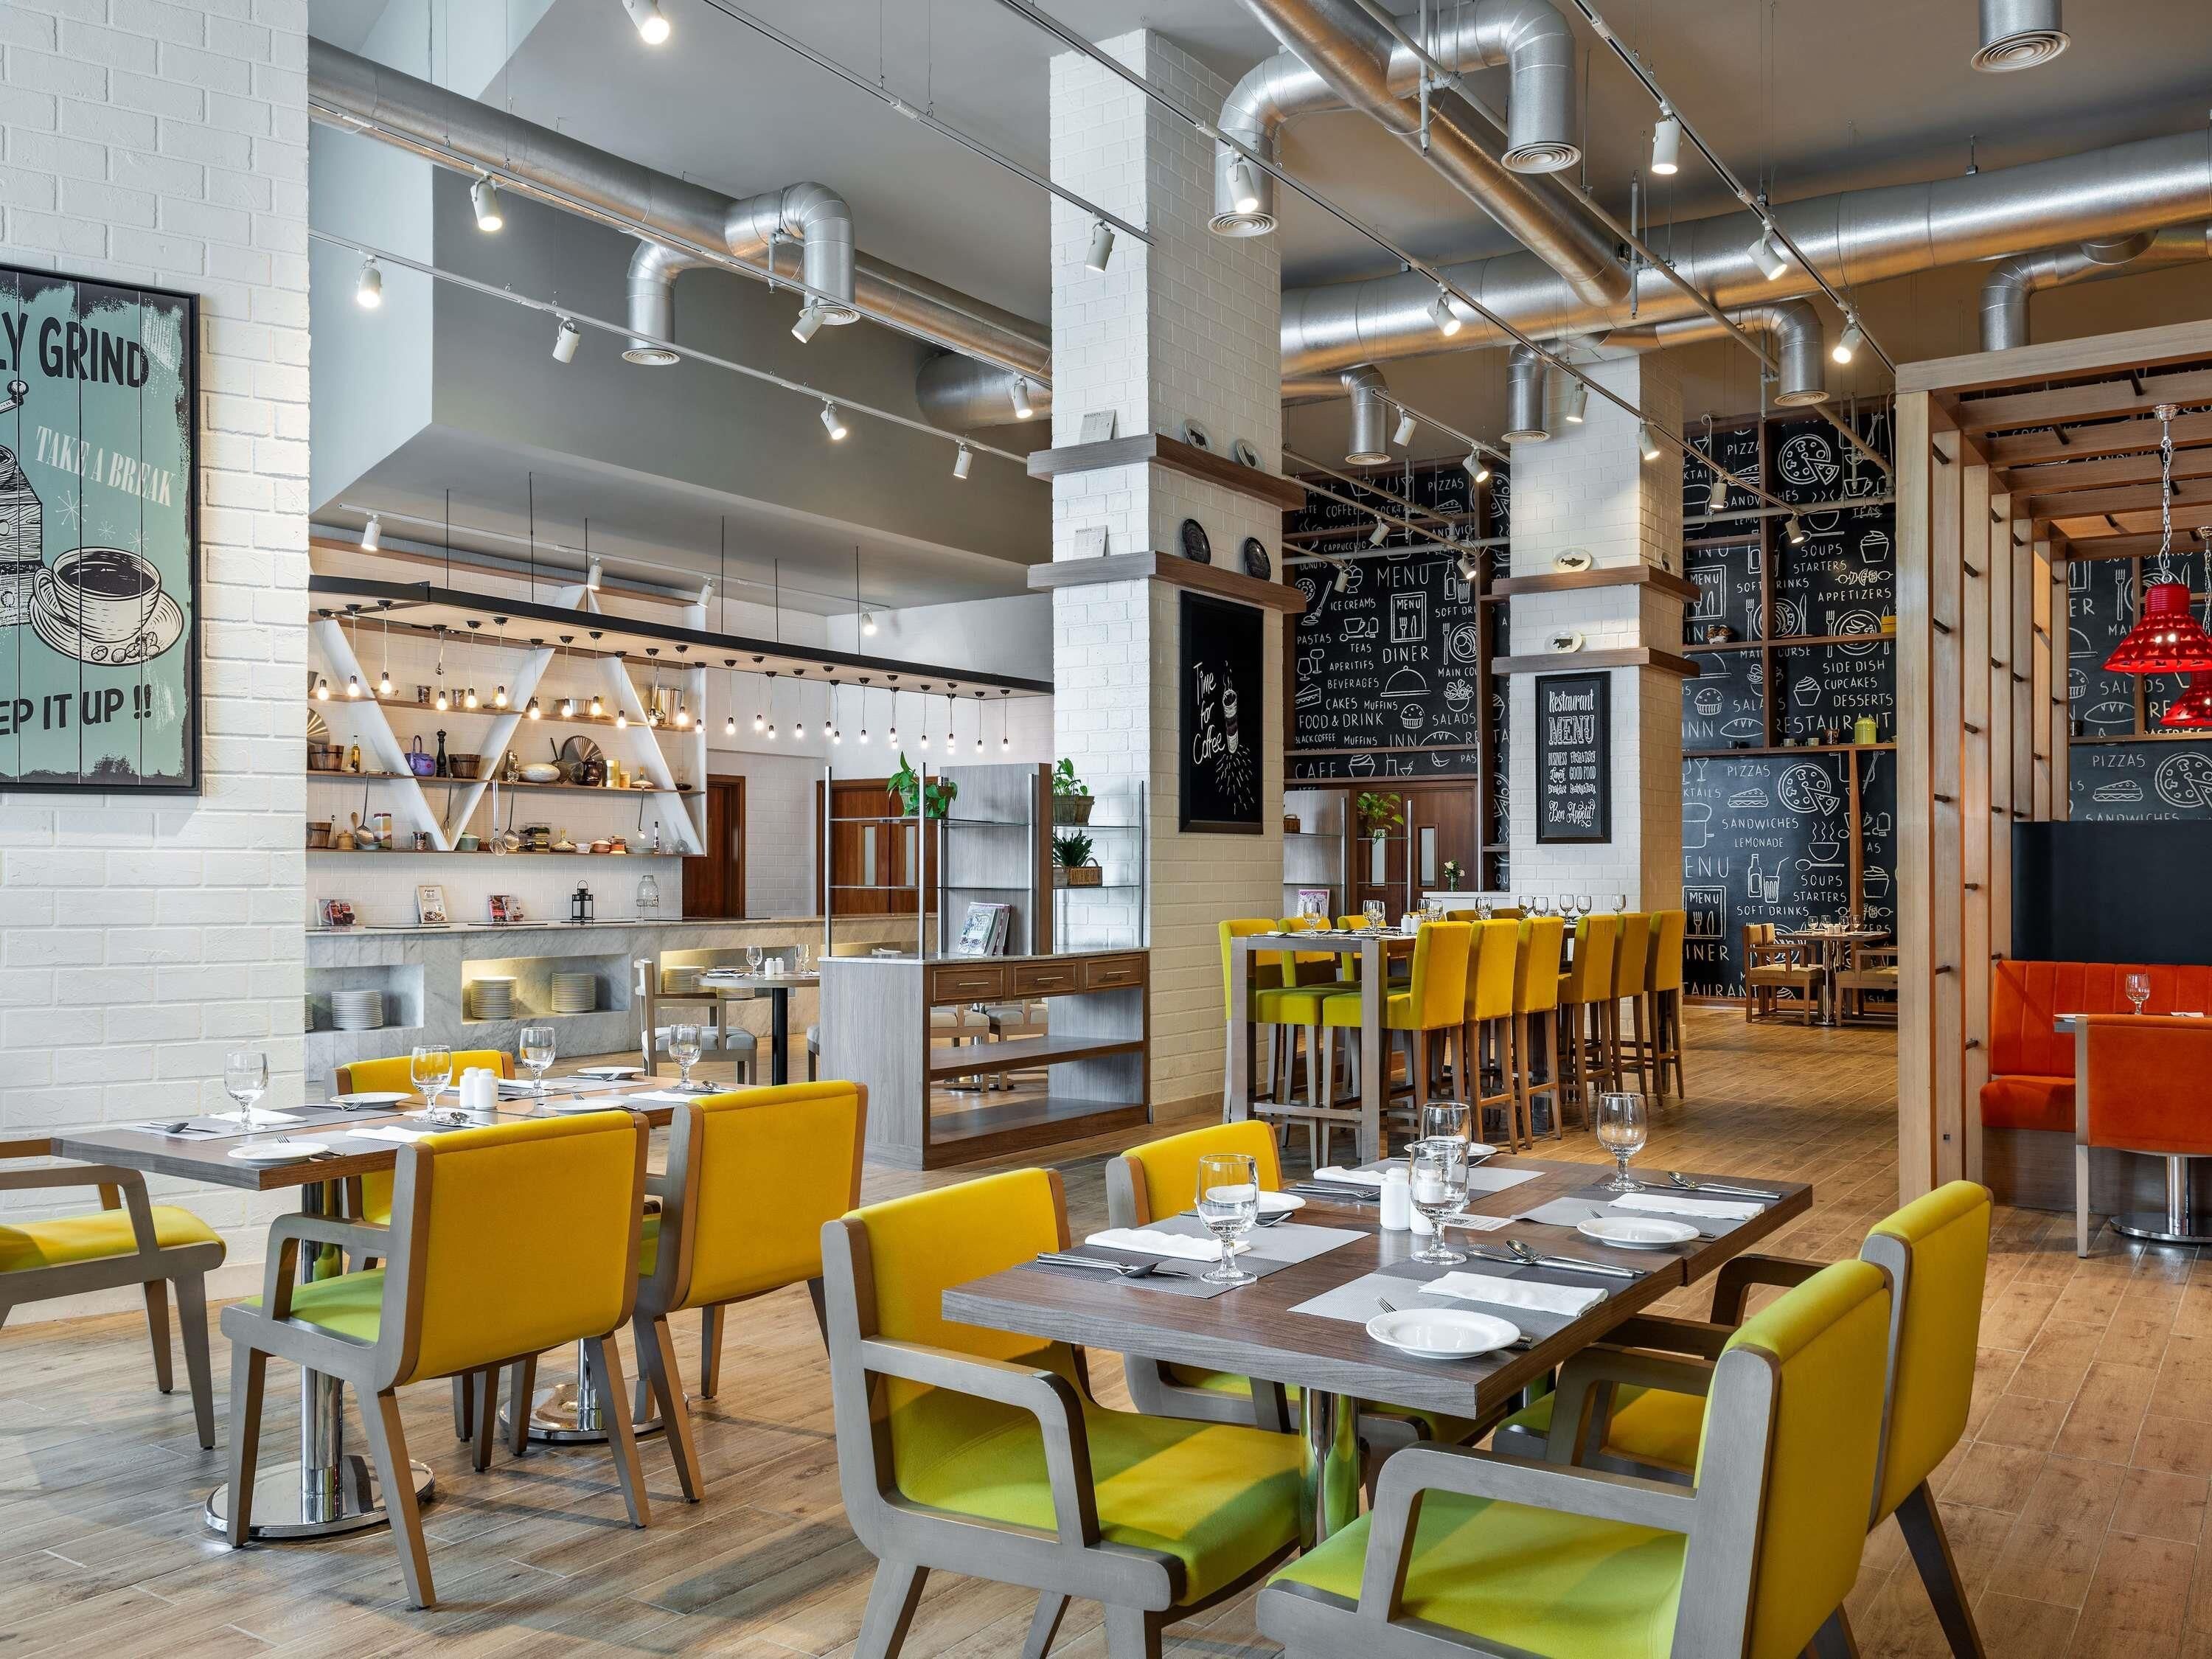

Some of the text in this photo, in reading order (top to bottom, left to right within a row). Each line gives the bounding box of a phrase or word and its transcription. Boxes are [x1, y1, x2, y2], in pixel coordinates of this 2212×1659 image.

[39, 316, 149, 388] GRIND
[36, 425, 175, 507] TAKE A BREAK
[1427, 477, 1464, 491] PIZZAS
[1801, 543, 1843, 557] SOUPS
[1793, 560, 1847, 574] STARTERS
[1377, 563, 1429, 588] MENU
[1690, 573, 1719, 586] MENU
[1736, 581, 1762, 594] SOFT
[1818, 588, 1892, 602] APPETIZERS
[1330, 597, 1376, 611] ICE CREAMS
[1397, 599, 1421, 611] MENU
[1435, 606, 1458, 618] SOFT
[1297, 633, 1332, 645] PASTAS
[1351, 643, 1371, 653] TEAS
[1382, 645, 1430, 664] DINER
[1329, 660, 1374, 671] APERITIFS
[1438, 667, 1461, 678] MAIN
[1823, 660, 1885, 674] SIDE DISH
[1327, 678, 1380, 689] BEVERAGES
[1824, 676, 1877, 689] CUPCAKES
[43, 693, 72, 730] IT
[81, 688, 125, 726] UP
[133, 684, 152, 720] !!
[1326, 697, 1398, 711] CAKES MUFFINS
[1549, 688, 1594, 713] Restaurant
[1834, 693, 1893, 707] DESSERTS
[1200, 700, 1214, 730] for
[1299, 712, 1384, 729] FOOD & DRINK
[1432, 712, 1476, 726] SALADS
[1548, 714, 1595, 746] MENU
[1193, 724, 1225, 765] Coffee
[1314, 734, 1336, 742] COFFEE
[1343, 735, 1377, 746] MUFFINS
[2093, 754, 2146, 768] PIZZAS
[1569, 766, 1583, 780] GOOD
[1583, 765, 1596, 779] FOOD
[1727, 765, 1770, 777] PIZZAS
[1548, 800, 1565, 822] Bon
[1722, 817, 1799, 830] SANDWICHES
[1735, 837, 1784, 848] LEMONADE
[1801, 874, 1843, 886] SOUPS
[1689, 891, 1719, 904] MENU
[1793, 891, 1847, 902] STARTERS
[1736, 905, 1809, 917] SOFT DRINKS
